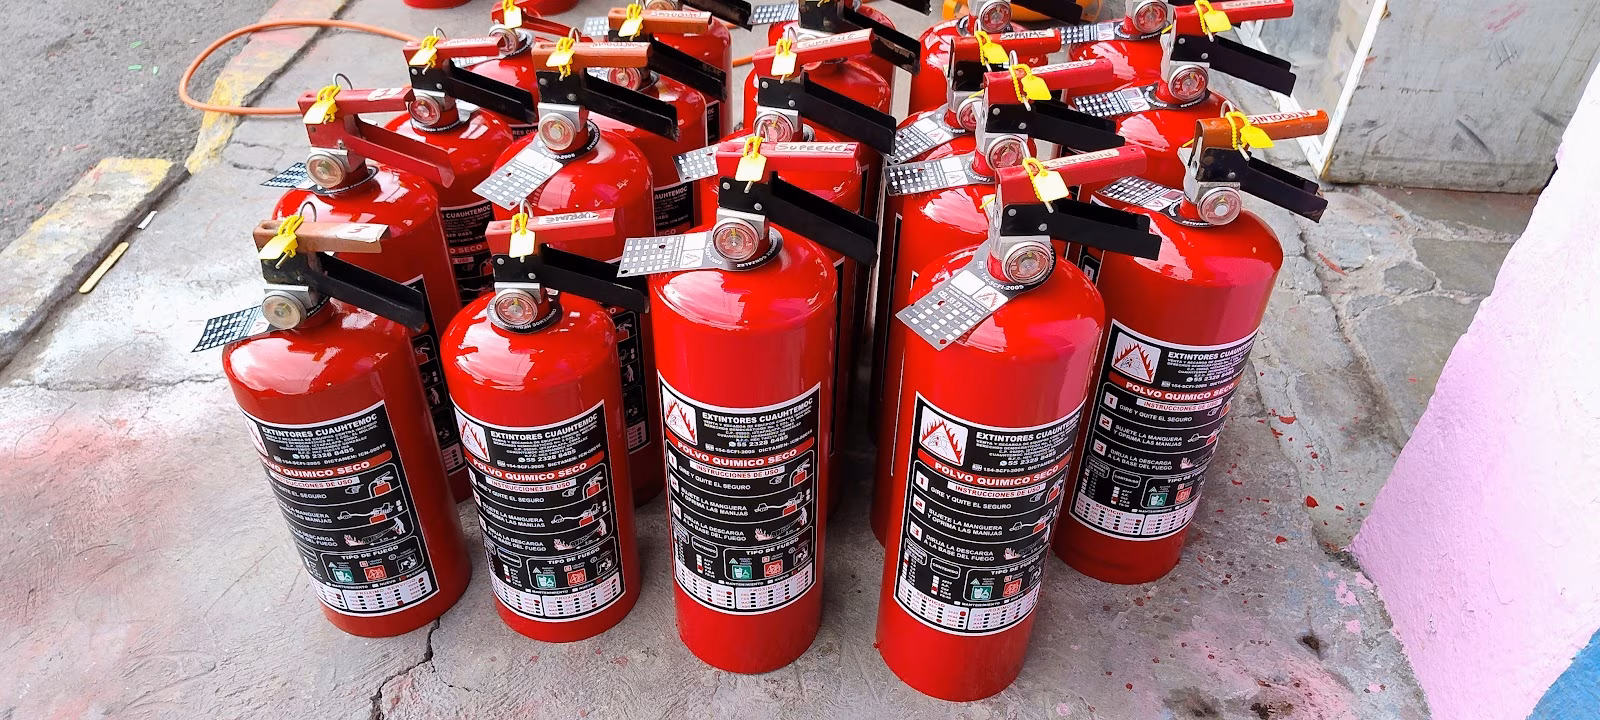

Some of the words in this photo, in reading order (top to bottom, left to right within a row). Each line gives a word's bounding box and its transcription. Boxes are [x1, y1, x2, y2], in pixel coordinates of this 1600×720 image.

[776, 144, 844, 152] SUPREME
[654, 186, 688, 200] AUHTEMOC
[446, 204, 492, 218] CUAUHTEMOC
[459, 244, 483, 252] SECO
[1167, 351, 1218, 360] EXTINTORES
[1126, 381, 1162, 398] POLVO
[1164, 392, 1211, 400] QUIMICO
[702, 411, 758, 424] EXTINTORES
[759, 398, 814, 422] CUAUHTEMOC
[1143, 401, 1198, 412] INSTRUCCIONES
[1119, 405, 1133, 414] GIRE
[1139, 412, 1157, 422] QUITE
[261, 426, 314, 438] EXTINTORES
[315, 413, 378, 436] CUAUHTEMOC
[490, 430, 543, 440] EXTINTORES
[545, 413, 598, 438] CUAUHTEMOC
[1115, 425, 1138, 438] SUJETE
[749, 440, 769, 448] 2328
[770, 435, 789, 444] 8485
[975, 430, 1035, 442] EXTINTORES
[1118, 431, 1142, 444] OPRIMA
[312, 451, 332, 460] 2328
[334, 447, 355, 456] 8485
[677, 440, 709, 462] POLVO
[711, 455, 765, 468] QUIMICO
[767, 449, 798, 464] SECO
[1095, 444, 1104, 453] 3
[537, 454, 557, 462] 2328
[1007, 459, 1019, 468] 55
[1020, 457, 1040, 466] 2328
[1121, 458, 1137, 466] BASE
[1138, 457, 1172, 466] DESCARGA
[283, 467, 334, 478] QUIMICO
[336, 461, 371, 474] SECO
[473, 458, 503, 476] POLVO
[505, 471, 555, 482] QUIMICO
[558, 462, 587, 478] SECO
[695, 464, 753, 480] INSTRUCCIONES
[764, 468, 779, 476] USO
[934, 461, 974, 482] POLVO
[977, 476, 1031, 488] QUIMICO
[1033, 465, 1059, 482] SECO
[491, 480, 545, 492] INSTRUCCIONES
[694, 475, 713, 484] QUITE
[722, 482, 751, 490] SEGURO
[918, 477, 925, 486] 1
[955, 484, 1015, 498] INSTRUCCIONES
[1015, 489, 1025, 498] DE
[1026, 486, 1041, 494] USO
[914, 499, 924, 509] 2
[930, 486, 946, 498] GIRE
[946, 493, 952, 501] Y
[952, 495, 972, 506] QUITE
[982, 503, 1012, 512] SEGURO
[296, 508, 330, 518] MANGUERA
[706, 505, 719, 514] LAS
[719, 508, 749, 516] MANIJAS
[709, 501, 748, 512] MANGUERA
[305, 515, 333, 524] MANIJAS
[508, 513, 544, 522] MANGUERA
[517, 520, 546, 528] MANIJAS
[928, 508, 953, 522] SUJETE
[953, 518, 963, 526] LA
[963, 521, 1003, 532] MANGUERA
[701, 522, 709, 530] LA
[708, 525, 745, 536] DESCARGA
[912, 528, 920, 537] 3
[931, 514, 958, 530] OPRIMA
[957, 525, 971, 534] LAS
[972, 528, 1003, 538] MANIJAS
[509, 537, 544, 546] DESCARGA
[710, 530, 723, 540] DEL
[723, 533, 747, 542] FUEGO
[776, 537, 799, 550] FUEGO
[925, 534, 945, 550] DIRIJA
[945, 543, 956, 552] LA
[956, 546, 994, 558] DESCARGA
[373, 545, 399, 556] FUEGO
[577, 546, 600, 560] FUEGO
[929, 541, 937, 549] LA
[936, 545, 956, 556] BASE
[956, 552, 970, 560] DEL
[970, 554, 995, 562] FUEGO
[990, 567, 1008, 576] TIPO
